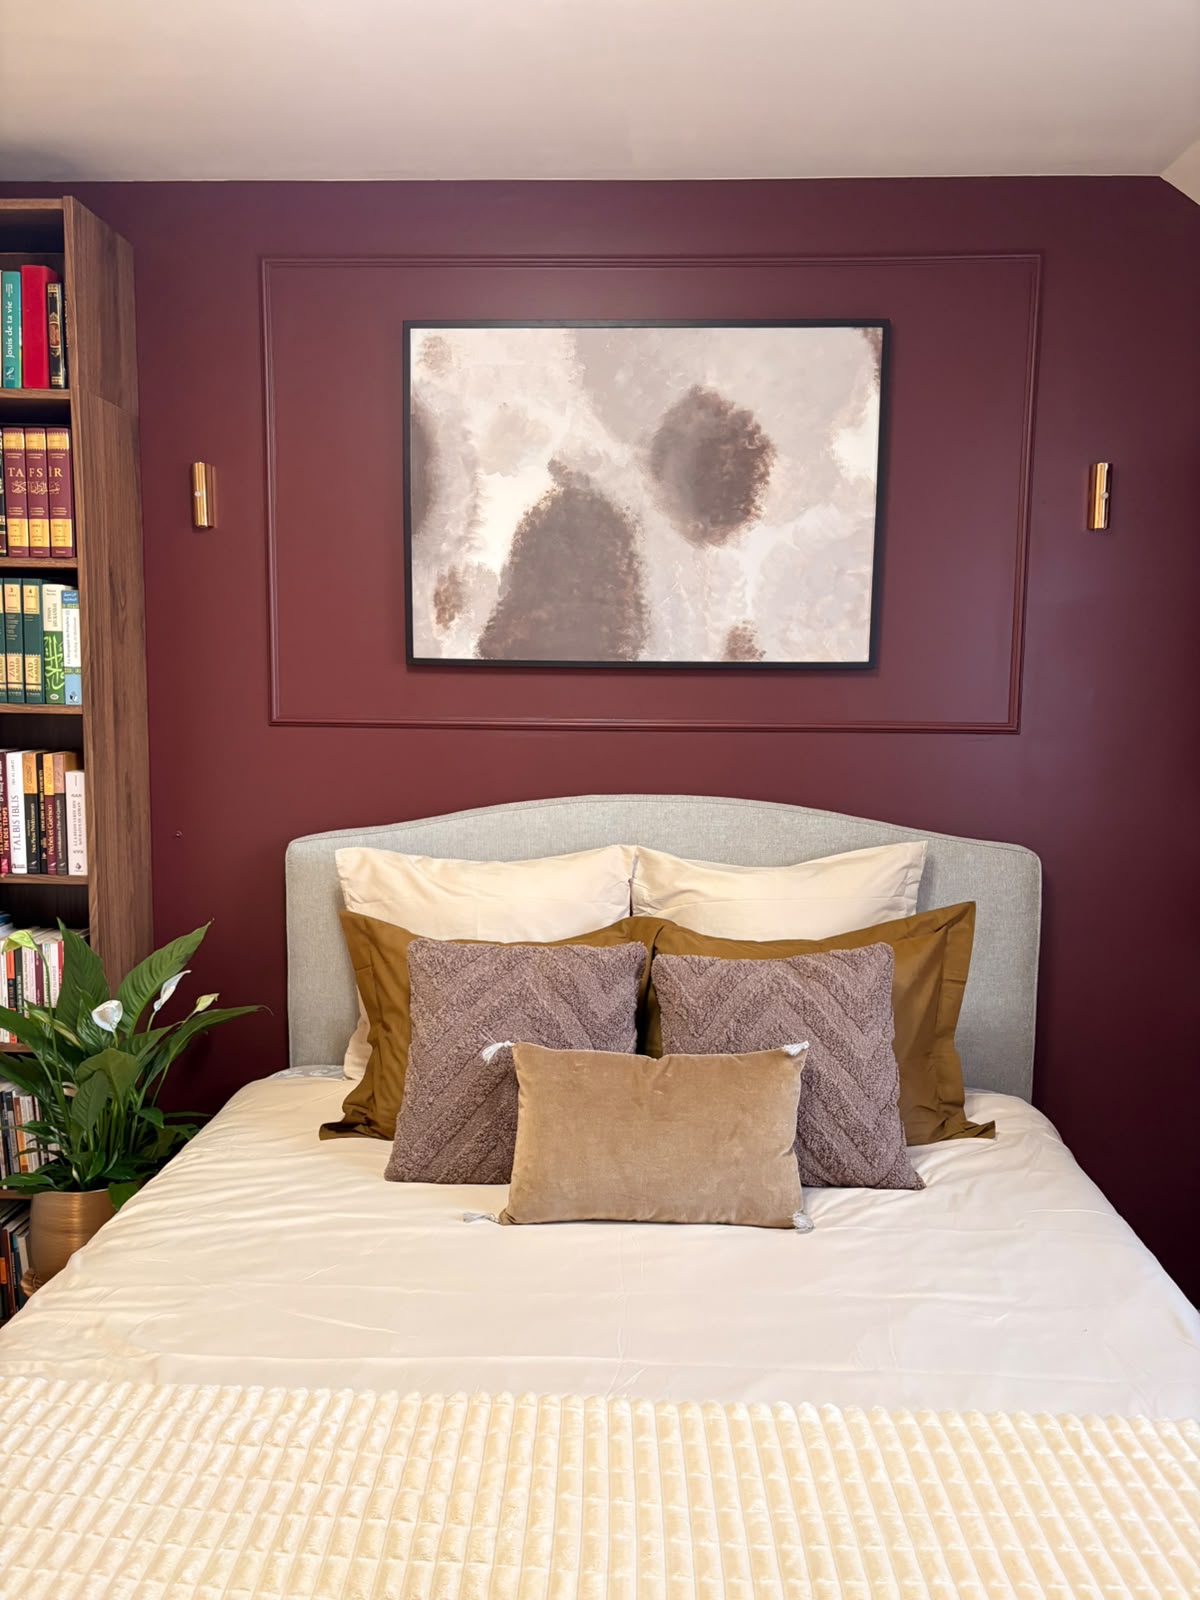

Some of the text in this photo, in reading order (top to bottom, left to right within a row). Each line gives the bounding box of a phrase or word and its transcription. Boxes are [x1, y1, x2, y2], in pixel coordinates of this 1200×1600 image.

[6, 315, 12, 324] ta
[5, 325, 12, 336] de
[5, 337, 15, 358] Jouis
[11, 795, 21, 851] TALBIS IBLIS
